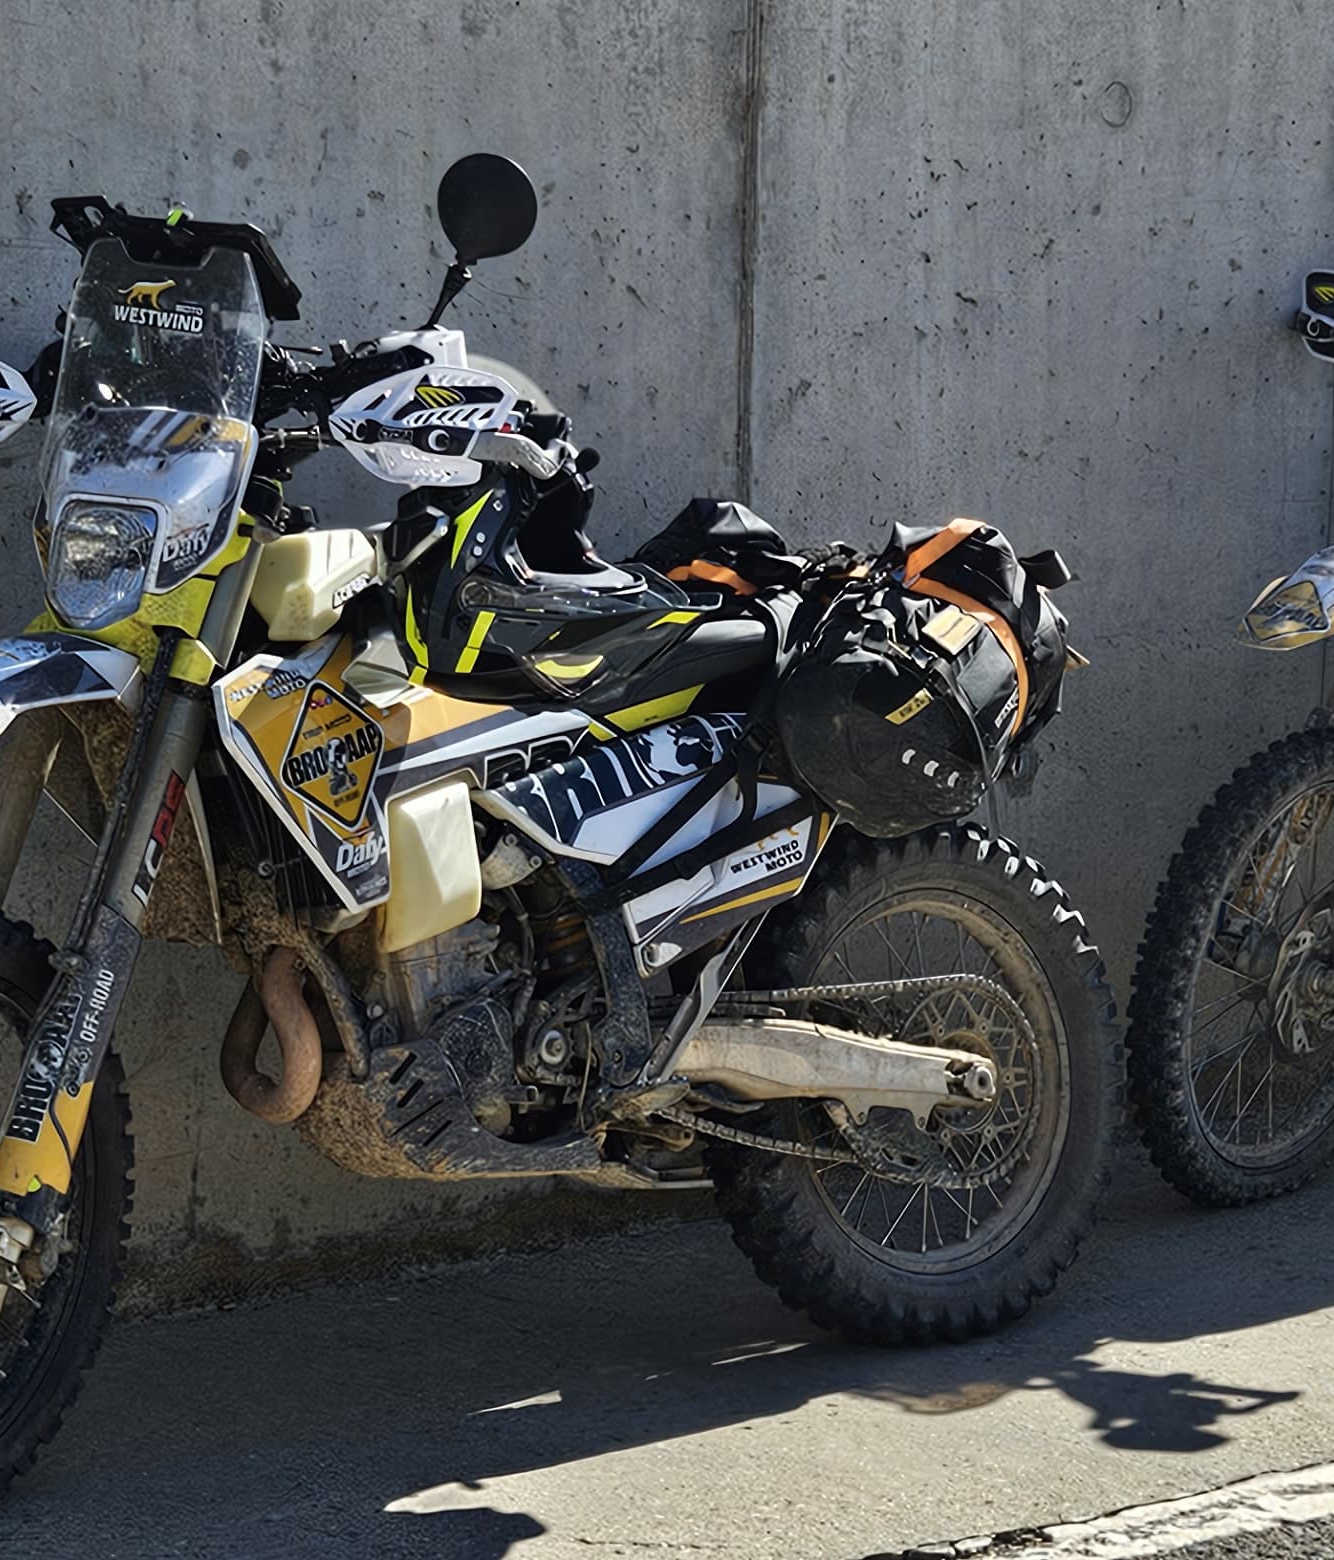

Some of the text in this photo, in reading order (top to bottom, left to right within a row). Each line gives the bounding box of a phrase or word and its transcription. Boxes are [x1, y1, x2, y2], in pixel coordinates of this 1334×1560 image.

[113, 304, 204, 333] WESTWIND
[729, 838, 800, 875] WESTWIND
[765, 850, 805, 872] MOTO
[80, 968, 115, 1044] OFF-ROAD
